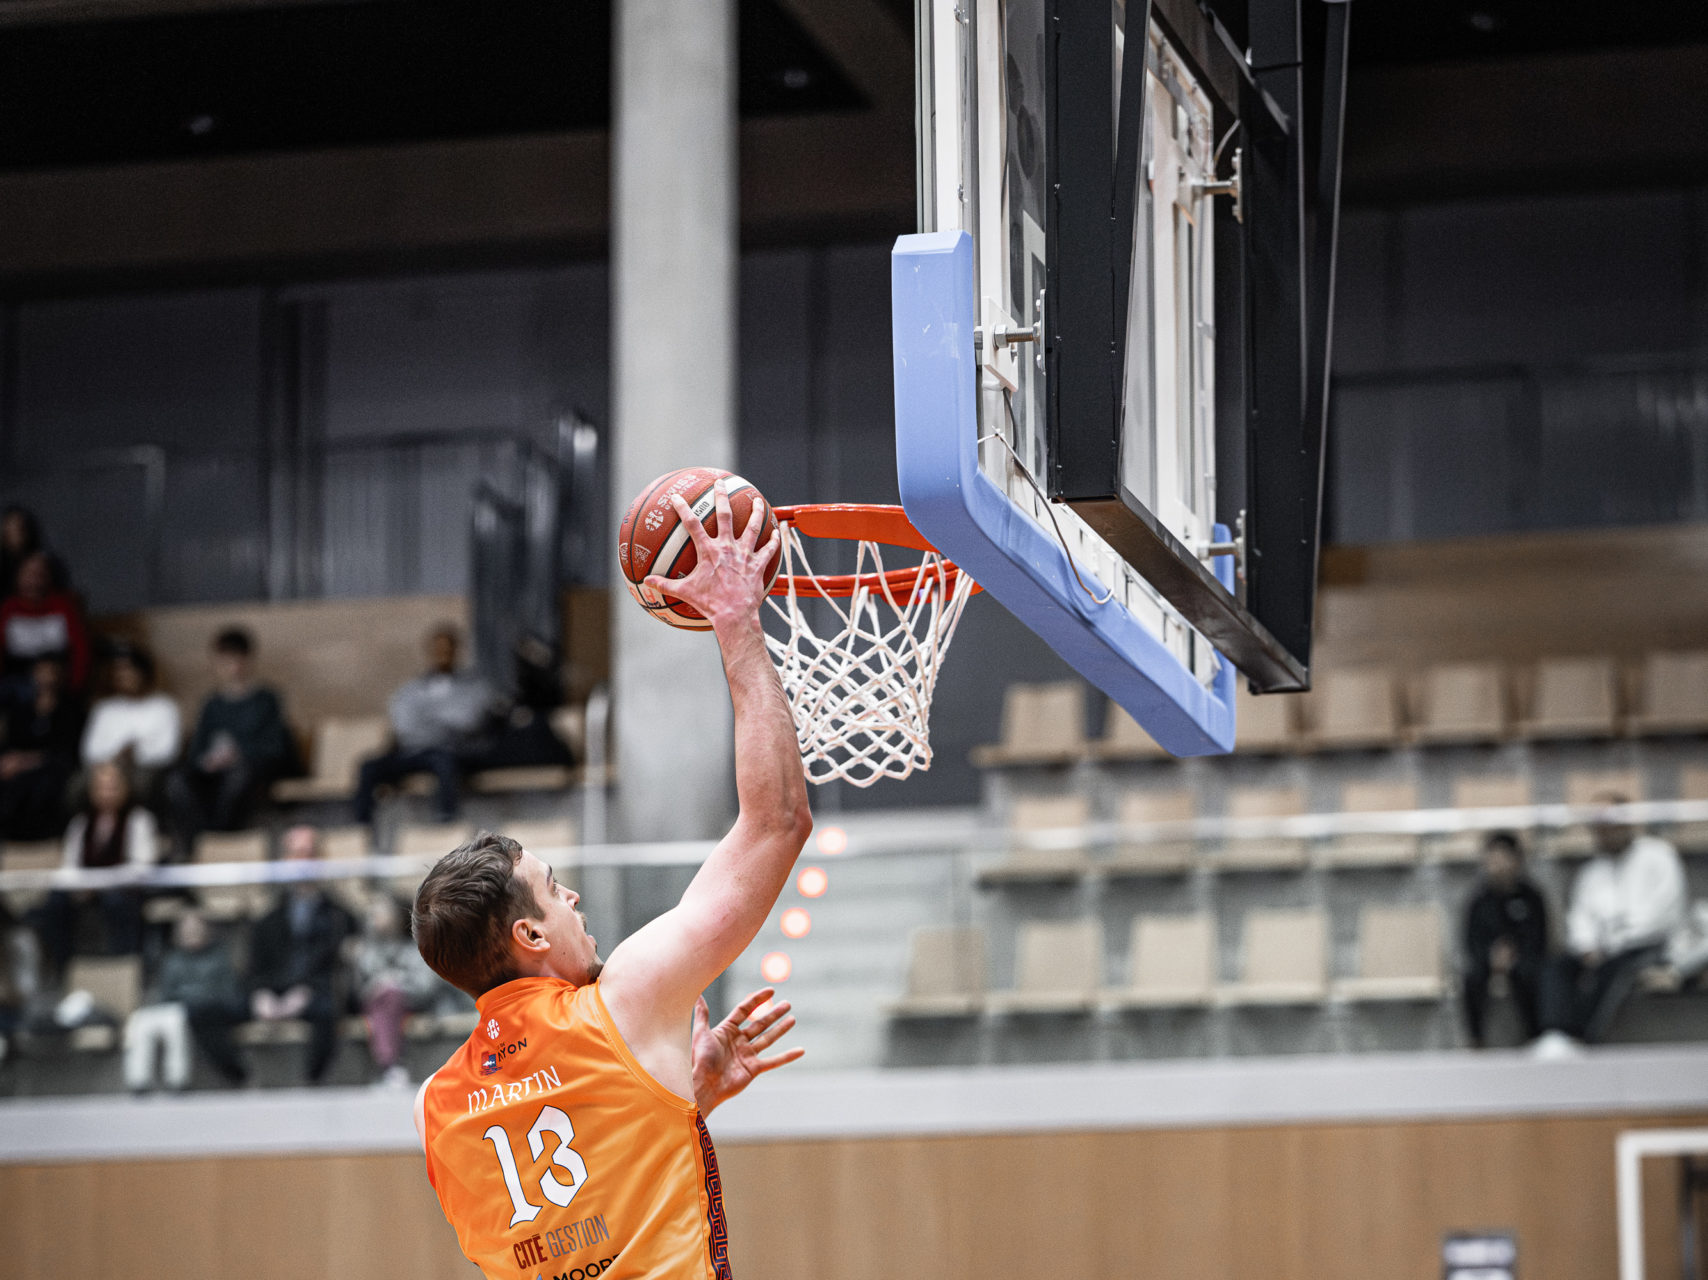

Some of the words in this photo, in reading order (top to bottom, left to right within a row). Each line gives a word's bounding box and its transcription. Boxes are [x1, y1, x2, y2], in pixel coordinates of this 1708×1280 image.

[468, 1065, 561, 1114] MARTIN
[482, 1105, 588, 1229] 13
[545, 1213, 610, 1258] GESTION
